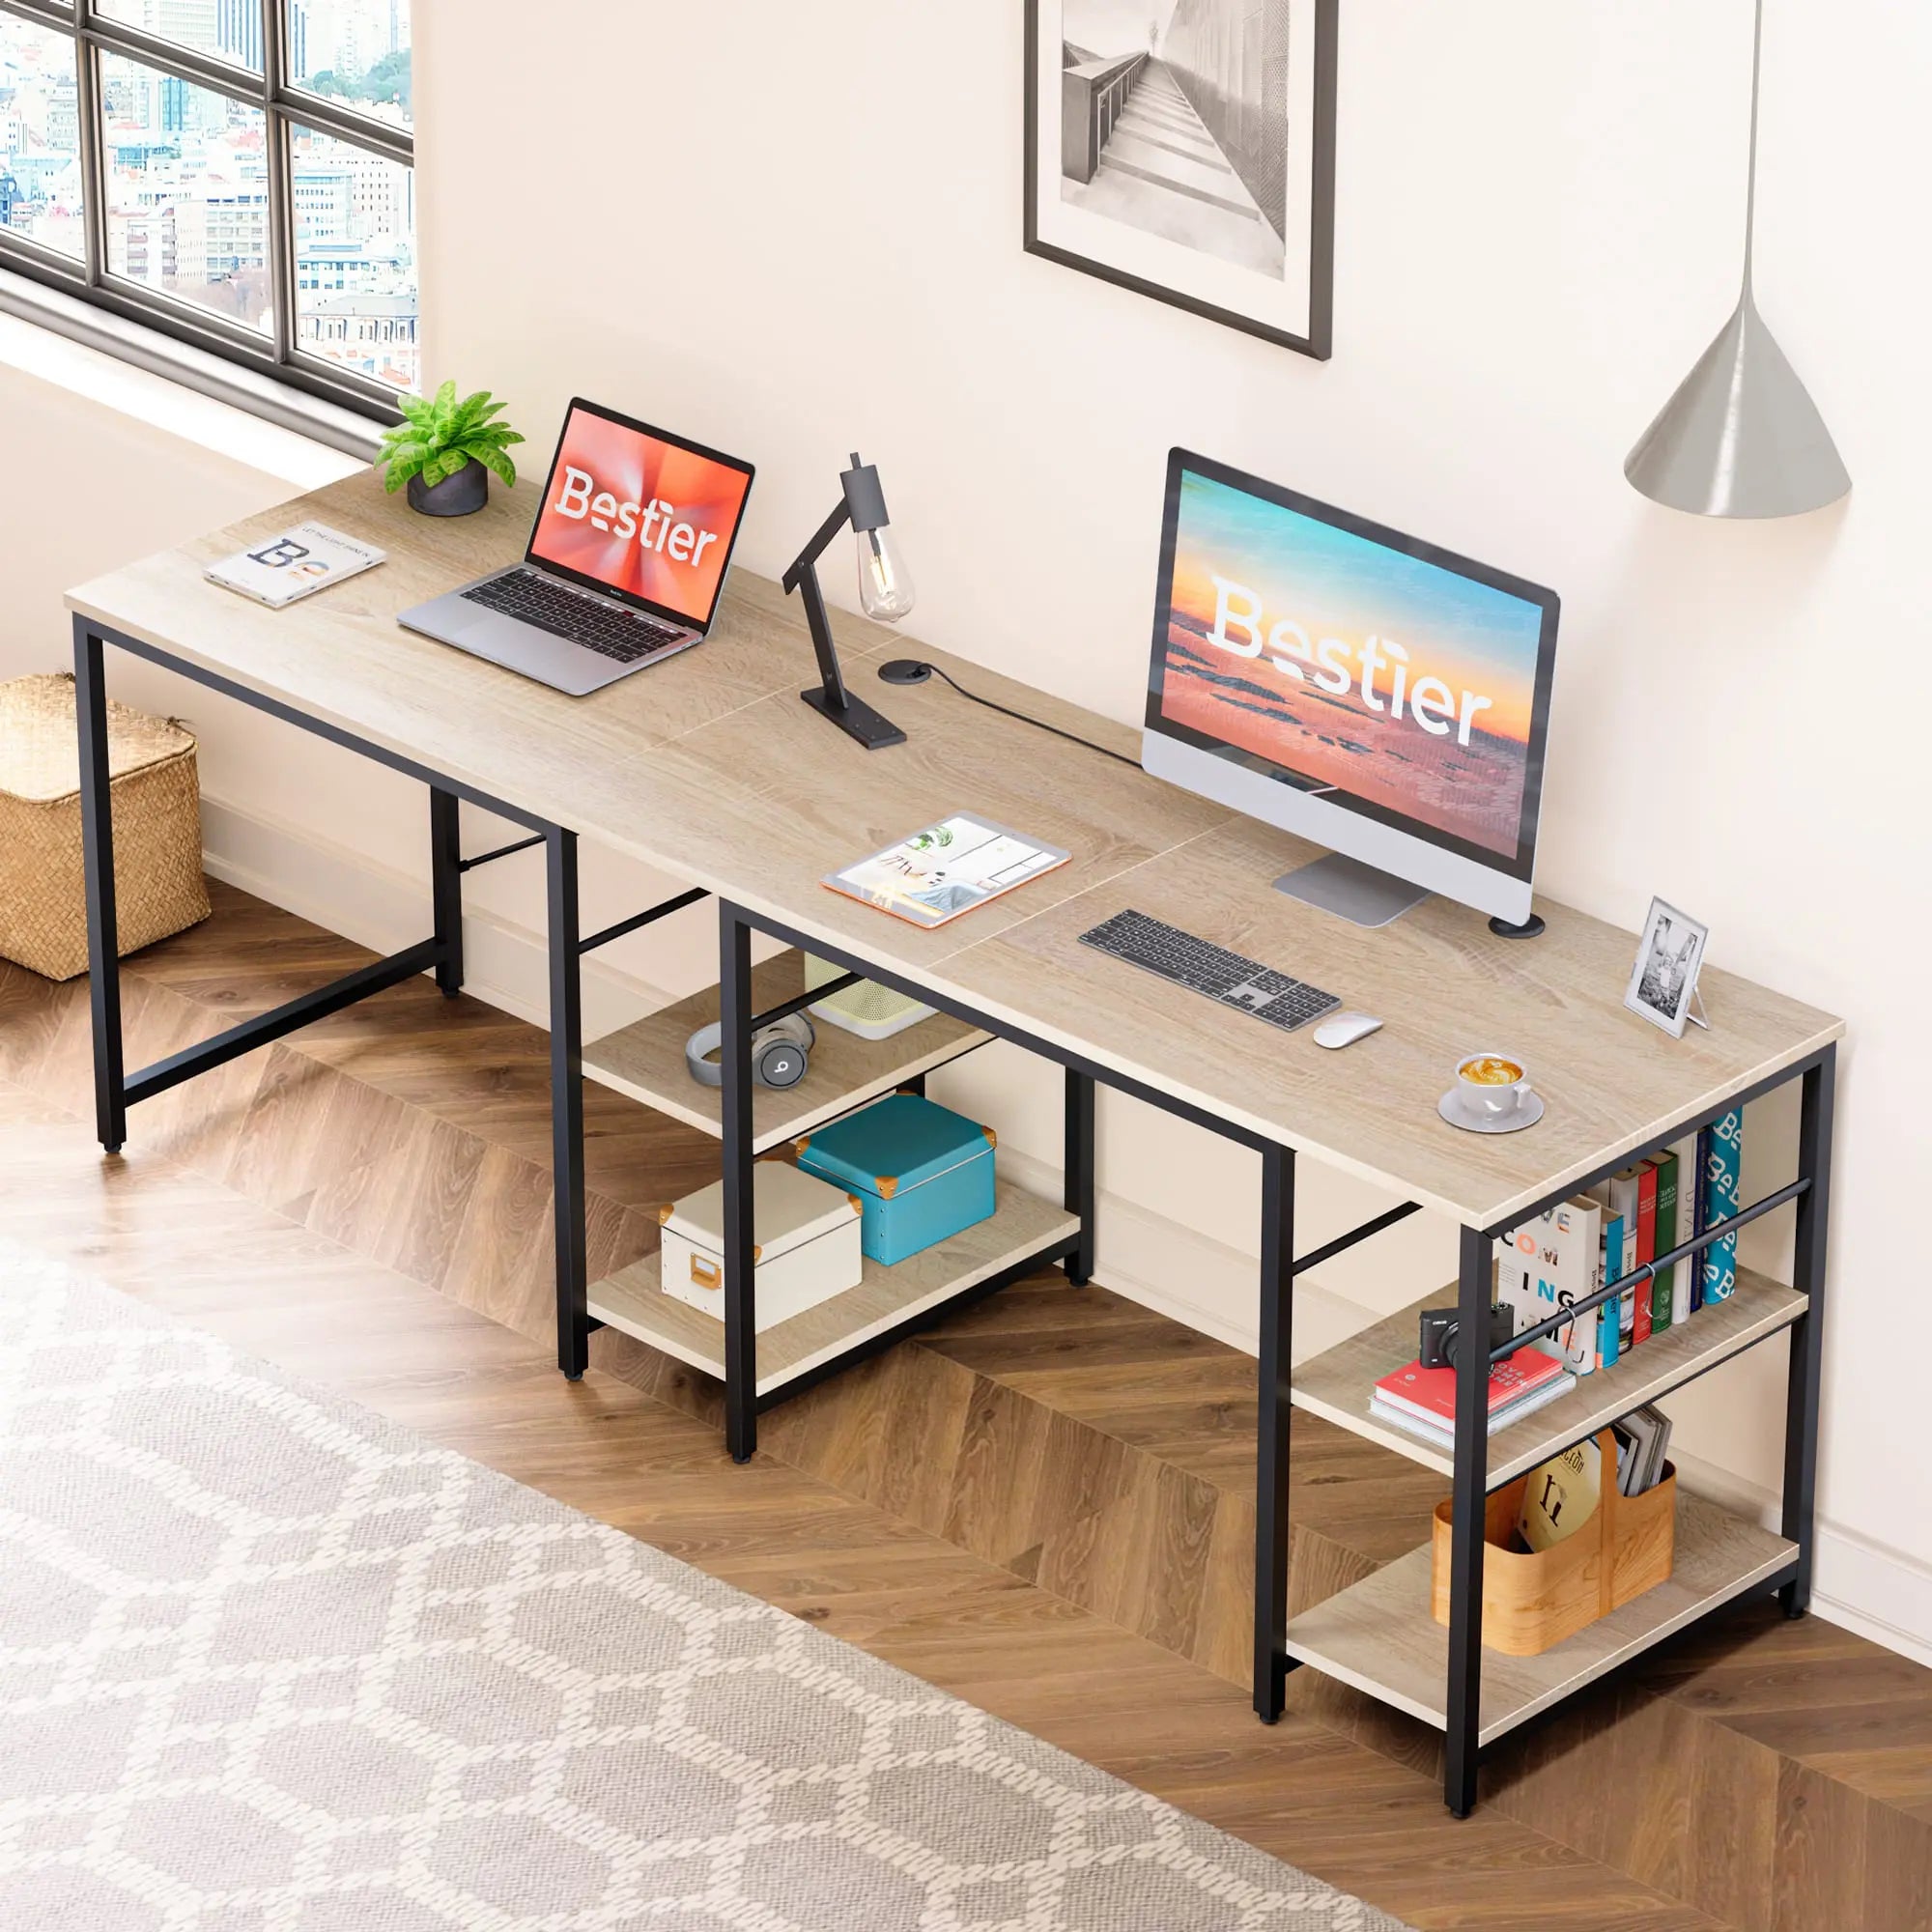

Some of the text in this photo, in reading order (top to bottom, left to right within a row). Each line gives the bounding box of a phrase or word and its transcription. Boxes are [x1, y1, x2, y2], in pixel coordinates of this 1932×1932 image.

[554, 465, 718, 568] Bestier
[1206, 574, 1492, 747] Bestier
[1522, 1271, 1575, 1308] ING
